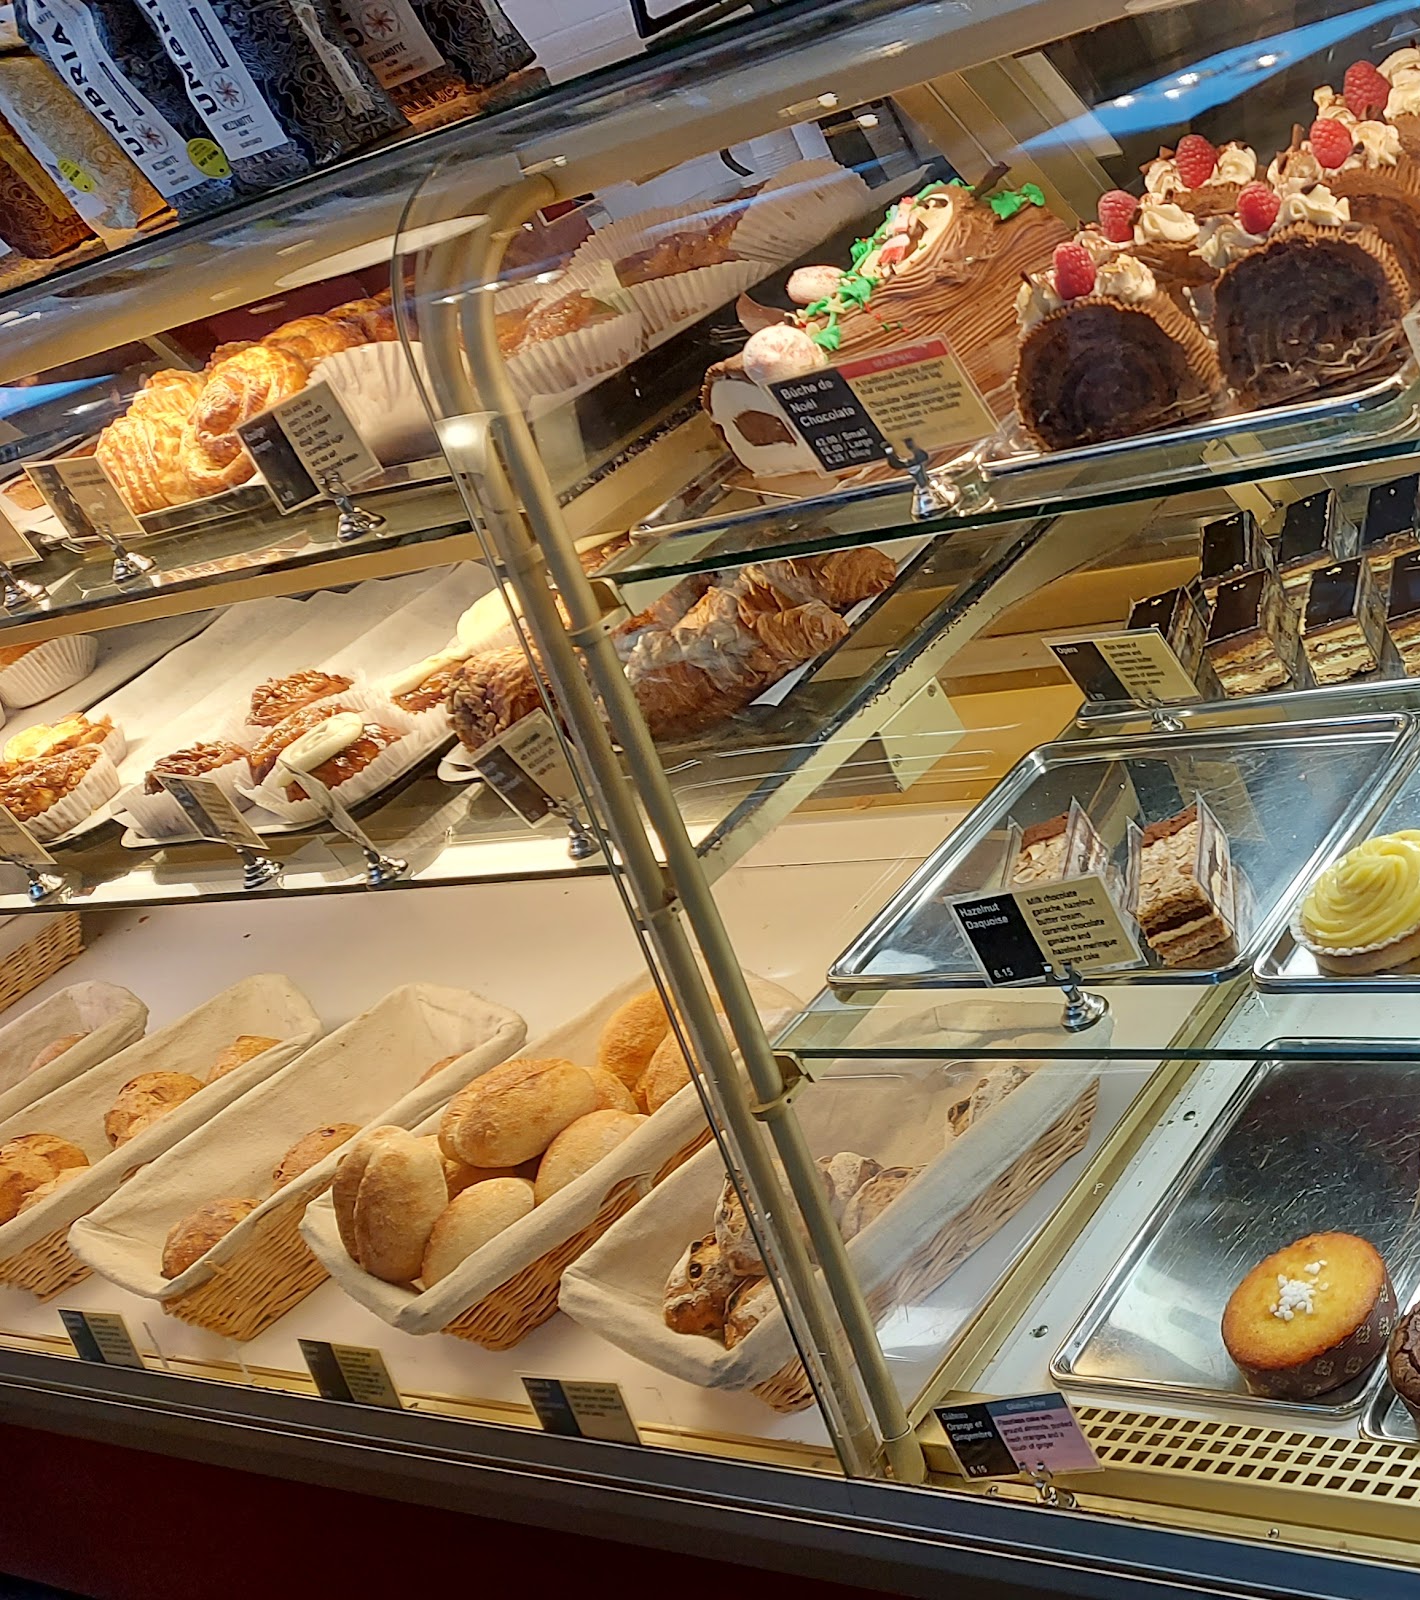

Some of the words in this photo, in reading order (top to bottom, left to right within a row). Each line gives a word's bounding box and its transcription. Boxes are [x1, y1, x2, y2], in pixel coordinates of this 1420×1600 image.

[51, 22, 147, 157] UMBRIA
[800, 407, 855, 427] Chocolate
[1056, 647, 1078, 655] Opera
[1026, 897, 1043, 906] Milk
[1043, 890, 1078, 901] chocolate
[1063, 898, 1096, 910] hazelnut
[959, 903, 1000, 918] Hazelnut
[1071, 918, 1105, 931] chocolate
[1078, 932, 1092, 940] and
[993, 968, 1014, 979] 6.15
[952, 1430, 993, 1441] Gingembre
